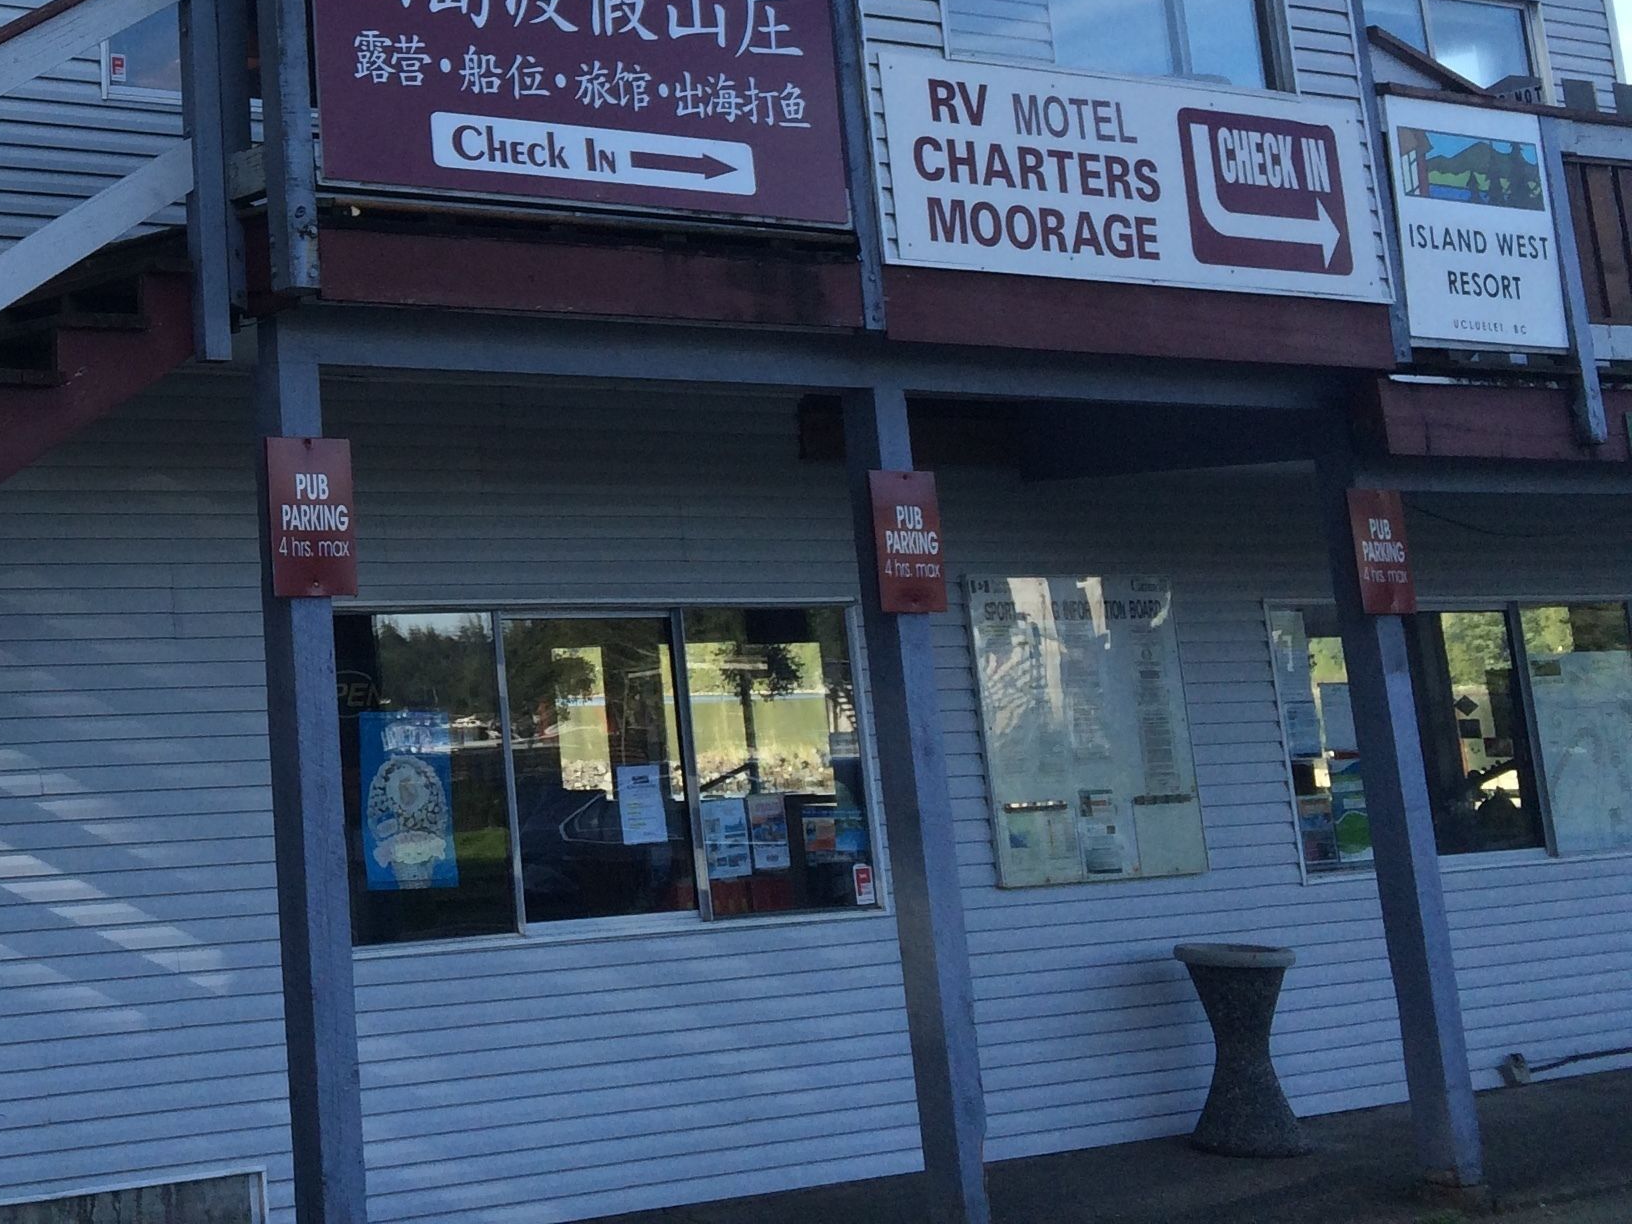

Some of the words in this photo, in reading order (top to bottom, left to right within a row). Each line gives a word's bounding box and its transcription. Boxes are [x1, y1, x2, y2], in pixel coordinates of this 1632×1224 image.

[928, 78, 988, 126] RV
[1012, 93, 1138, 143] MOTEL
[913, 136, 1160, 202] CHARTERS
[1217, 127, 1300, 189] CHECK
[1300, 137, 1331, 193] IN
[927, 197, 1160, 260] MOORAGE
[1409, 223, 1487, 254] ISLAND
[1496, 232, 1548, 260] WEST
[1447, 270, 1521, 300] RESORT
[295, 473, 329, 500] PUB
[281, 504, 349, 532] PARKING
[896, 505, 923, 530] PUB
[1369, 518, 1392, 540] PUB
[279, 537, 288, 556] 4
[319, 540, 350, 557] max
[885, 530, 939, 555] PARKING
[1362, 541, 1405, 563] PARKING
[885, 559, 893, 575] 4
[916, 563, 940, 578] max
